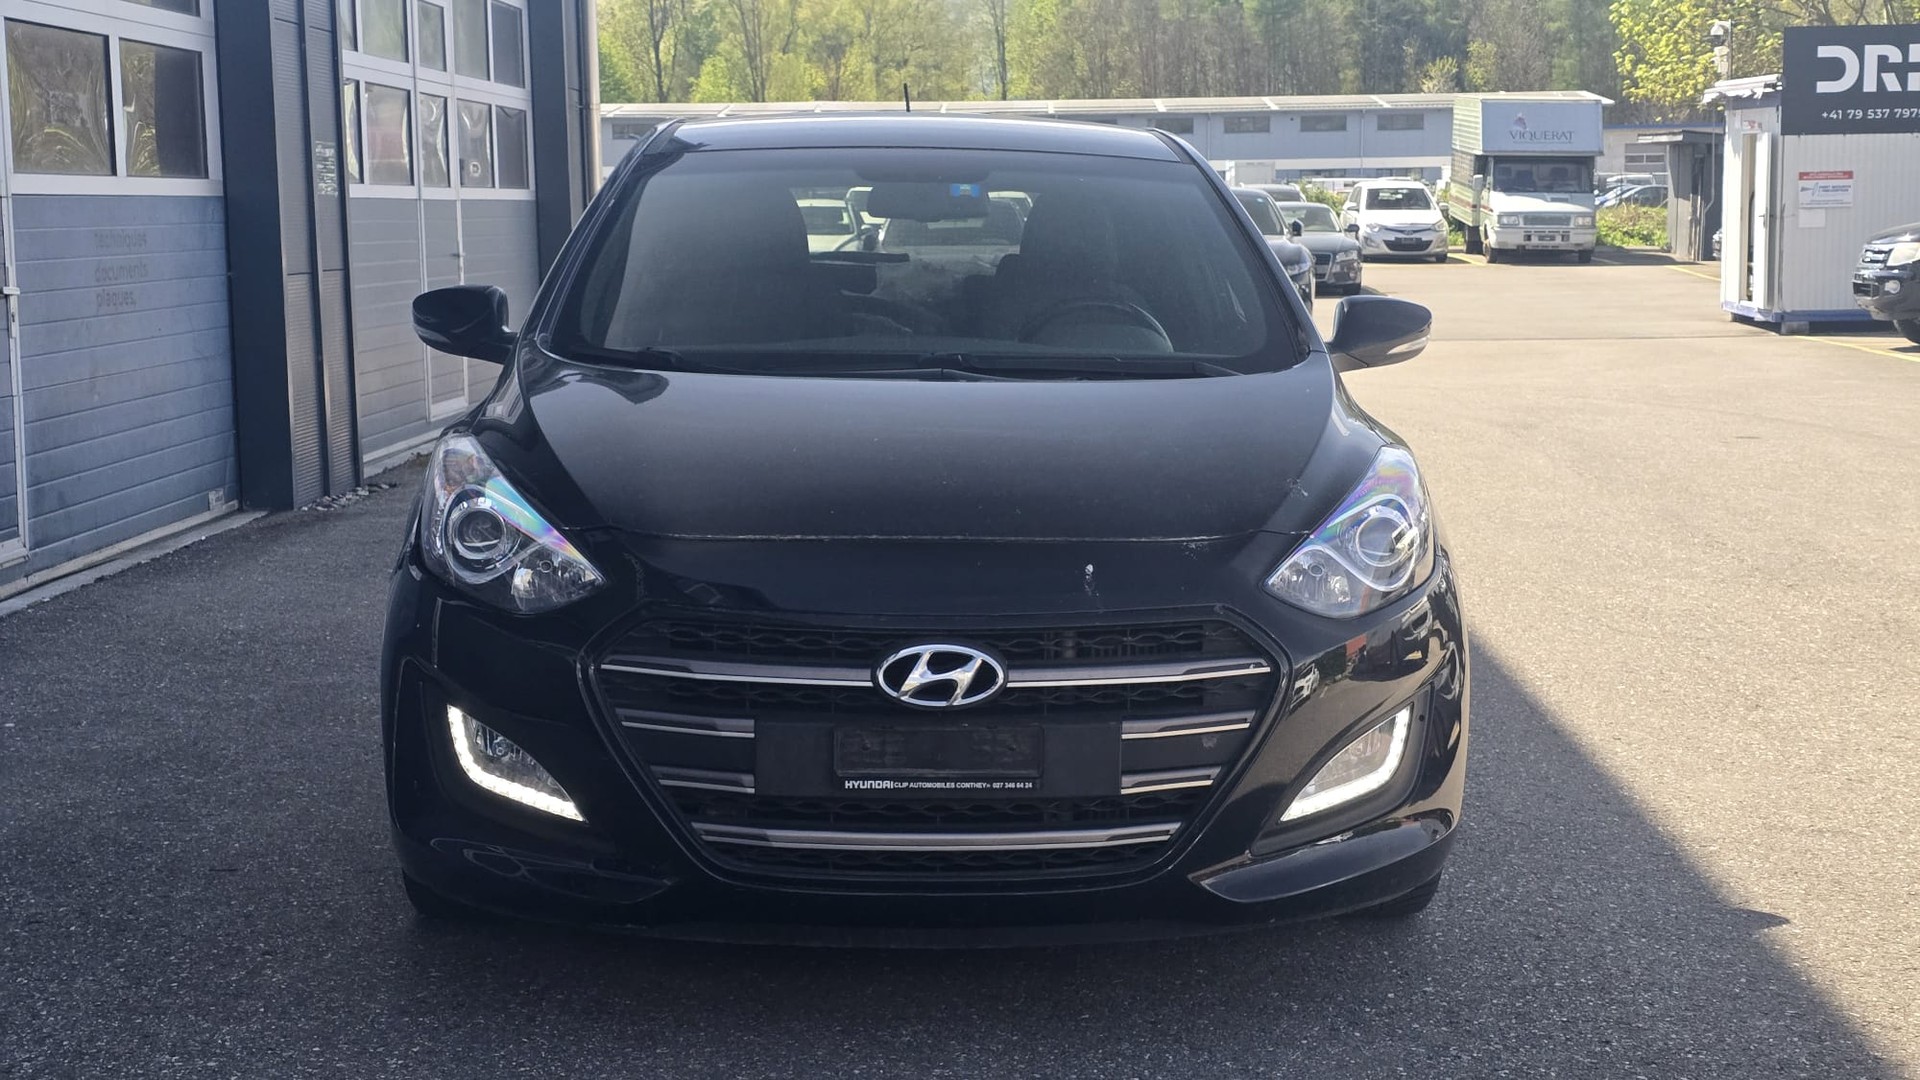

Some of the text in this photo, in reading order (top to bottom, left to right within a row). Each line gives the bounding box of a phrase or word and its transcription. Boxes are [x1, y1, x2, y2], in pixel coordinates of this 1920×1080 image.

[1822, 108, 1920, 119] +41 79 537 797
[1509, 130, 1575, 141] VIQUERAT
[845, 780, 894, 789] HYUNDAI
